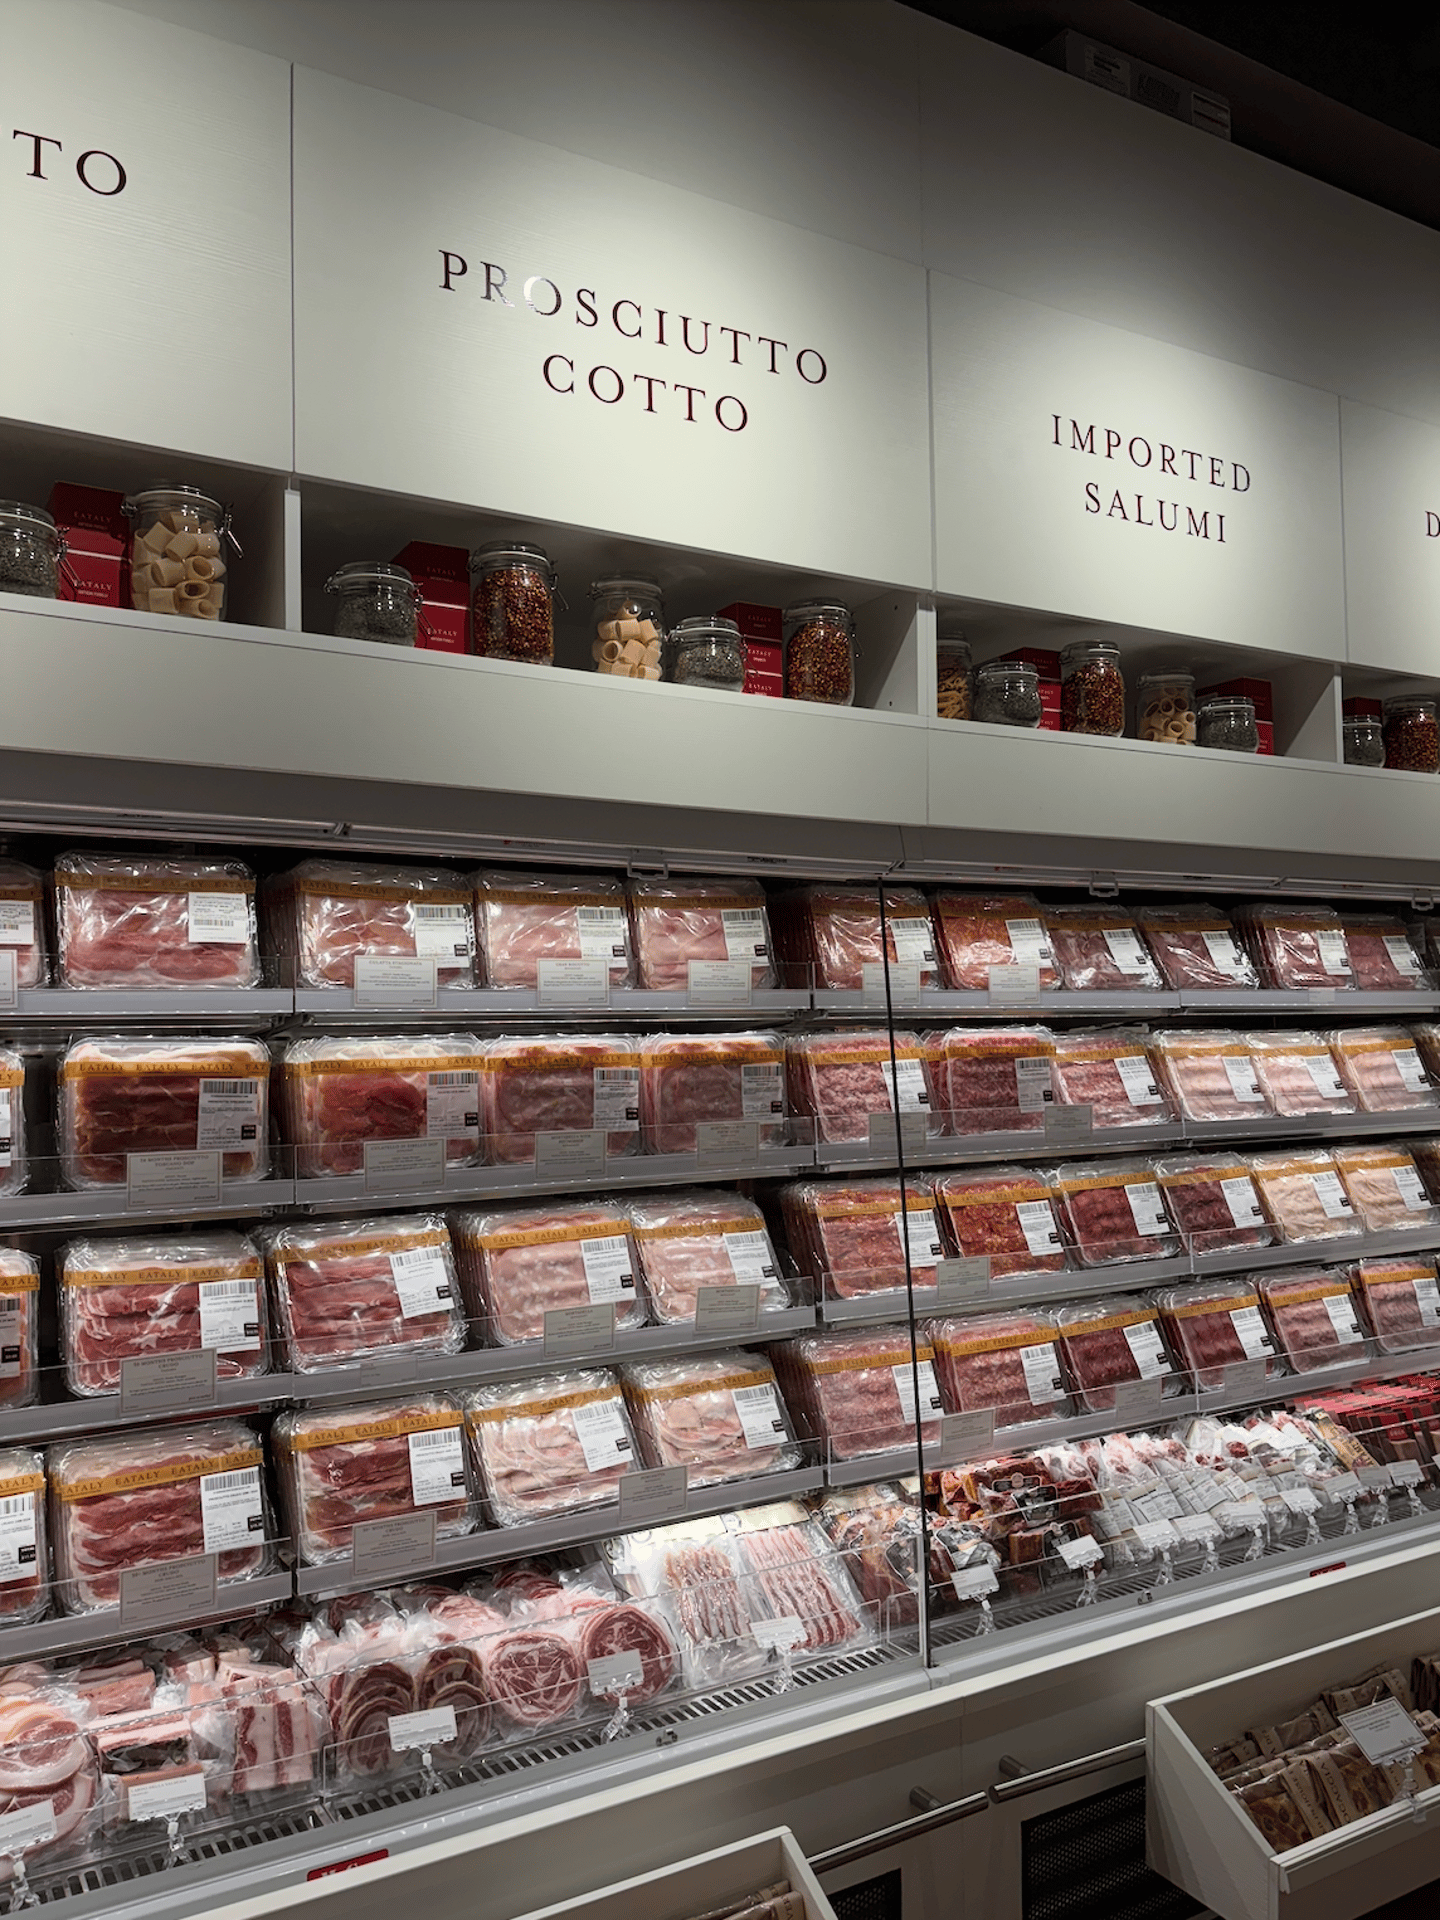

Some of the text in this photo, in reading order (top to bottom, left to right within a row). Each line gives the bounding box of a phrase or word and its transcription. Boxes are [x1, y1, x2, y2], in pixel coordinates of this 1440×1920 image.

[438, 249, 828, 385] PROSCIUTTO
[542, 354, 749, 433] COTTO
[1051, 413, 1251, 494] IMPORTED
[1084, 482, 1227, 544] SALUMI
[355, 1422, 395, 1436] EATALY
[115, 1471, 161, 1486] EATALY
[171, 1459, 216, 1475] EATALY
